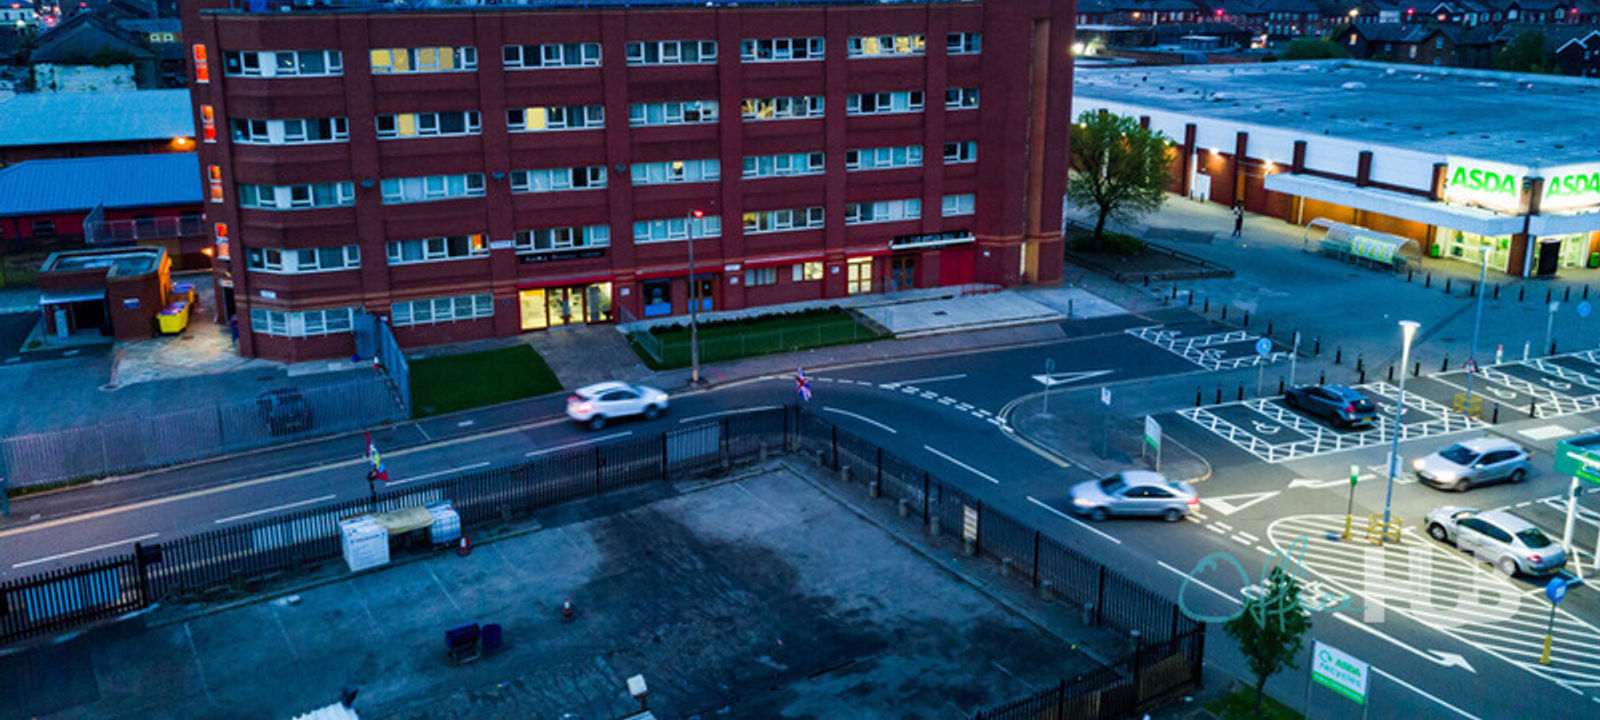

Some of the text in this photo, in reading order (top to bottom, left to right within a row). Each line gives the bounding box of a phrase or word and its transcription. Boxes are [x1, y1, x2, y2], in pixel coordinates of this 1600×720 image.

[1450, 166, 1517, 198] ASDA
[1545, 172, 1600, 198] ASDA
[1335, 659, 1361, 678] ASDA
